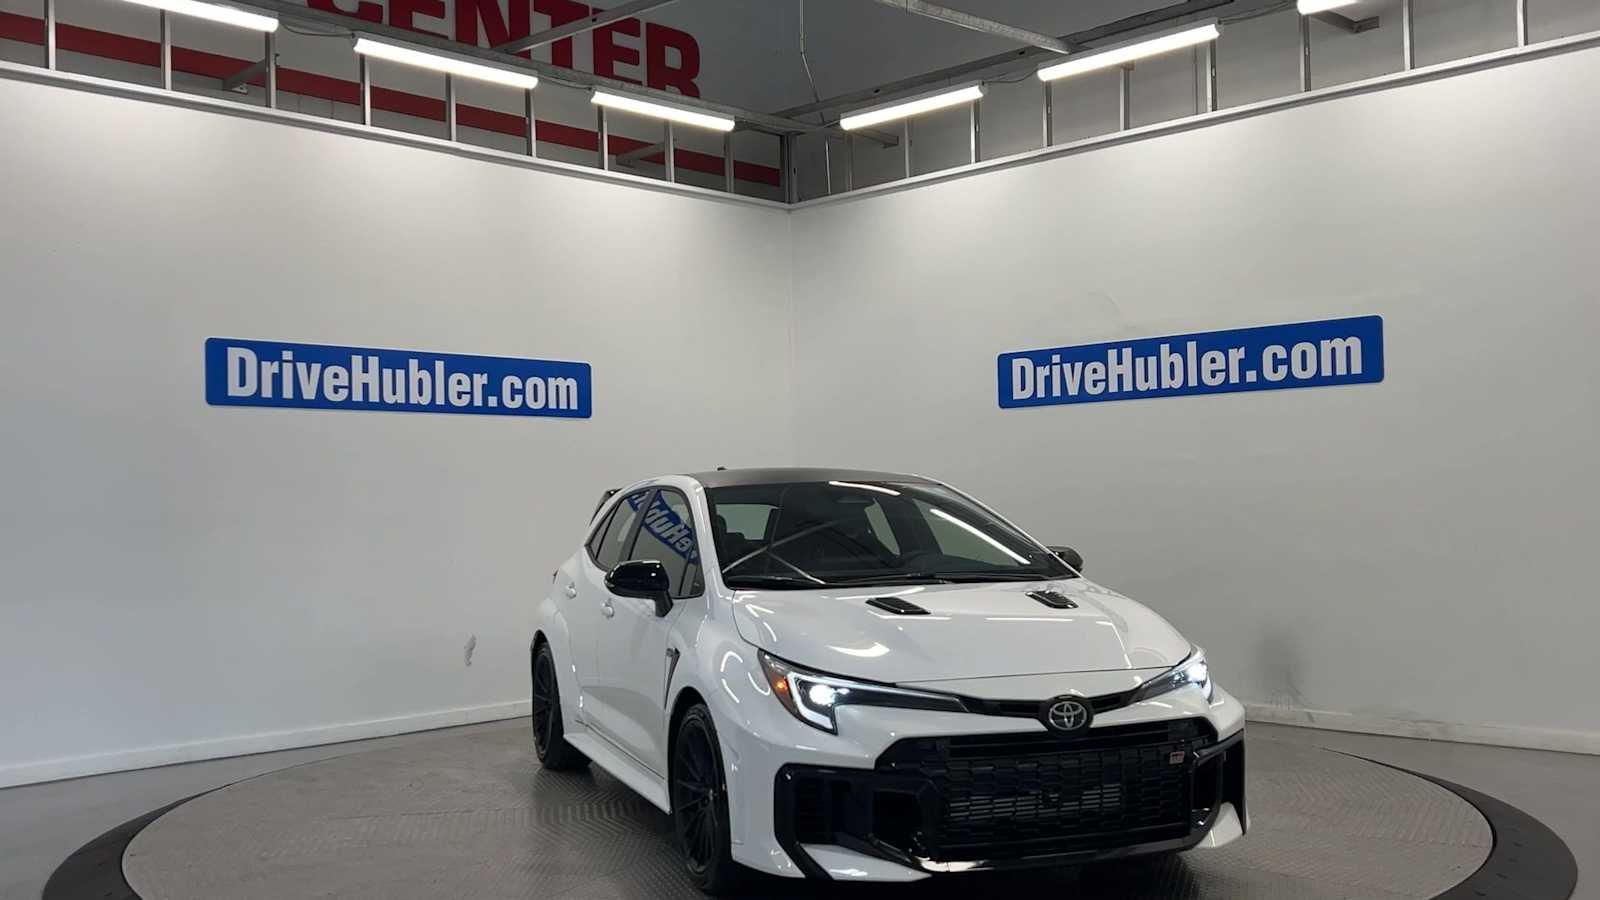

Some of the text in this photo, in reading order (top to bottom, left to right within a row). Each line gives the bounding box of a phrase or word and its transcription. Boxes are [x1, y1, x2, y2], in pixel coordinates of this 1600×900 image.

[306, 0, 701, 98] NTER
[226, 346, 579, 410] DriveHubler.com
[1011, 335, 1363, 400] DriveHubler.com
